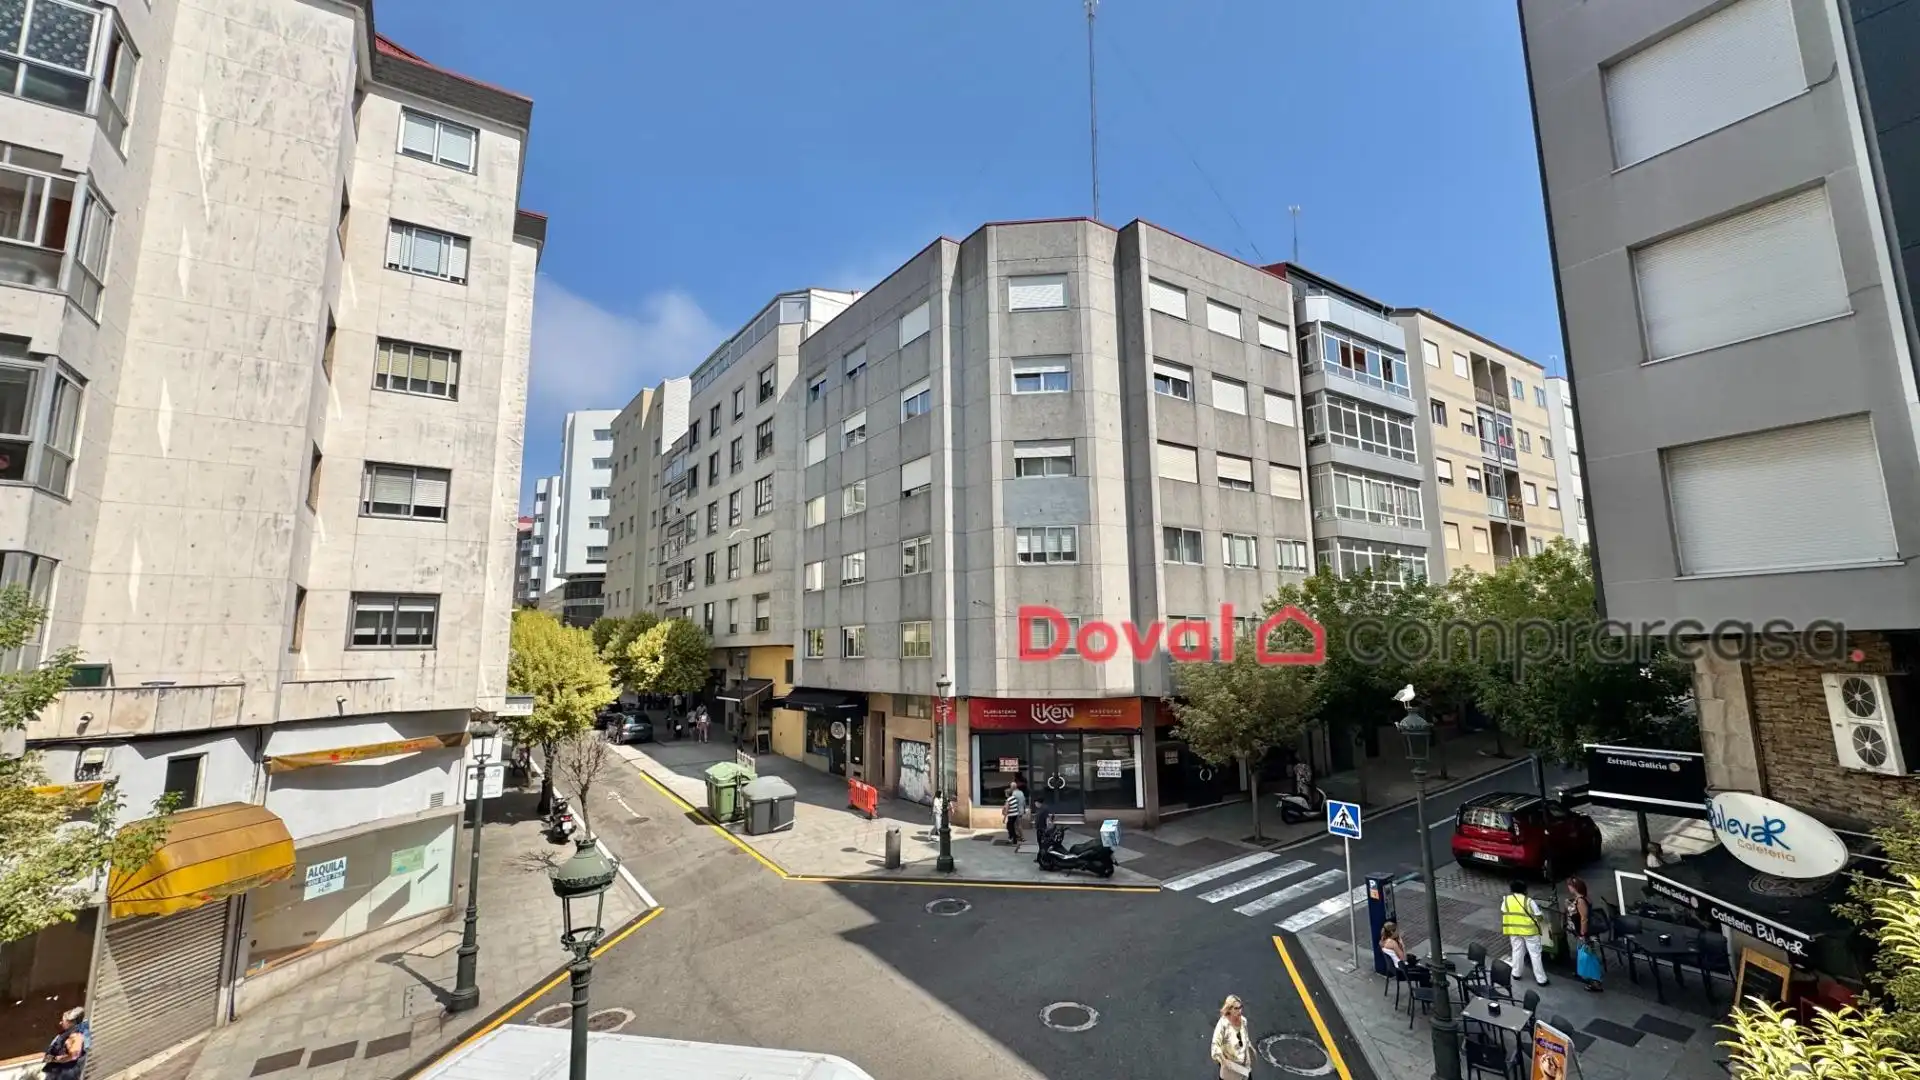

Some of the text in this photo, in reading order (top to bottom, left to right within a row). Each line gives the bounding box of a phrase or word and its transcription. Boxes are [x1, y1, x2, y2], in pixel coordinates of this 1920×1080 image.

[1607, 756, 1668, 771] Estrella Galicia
[308, 860, 344, 879] ALQUILA
